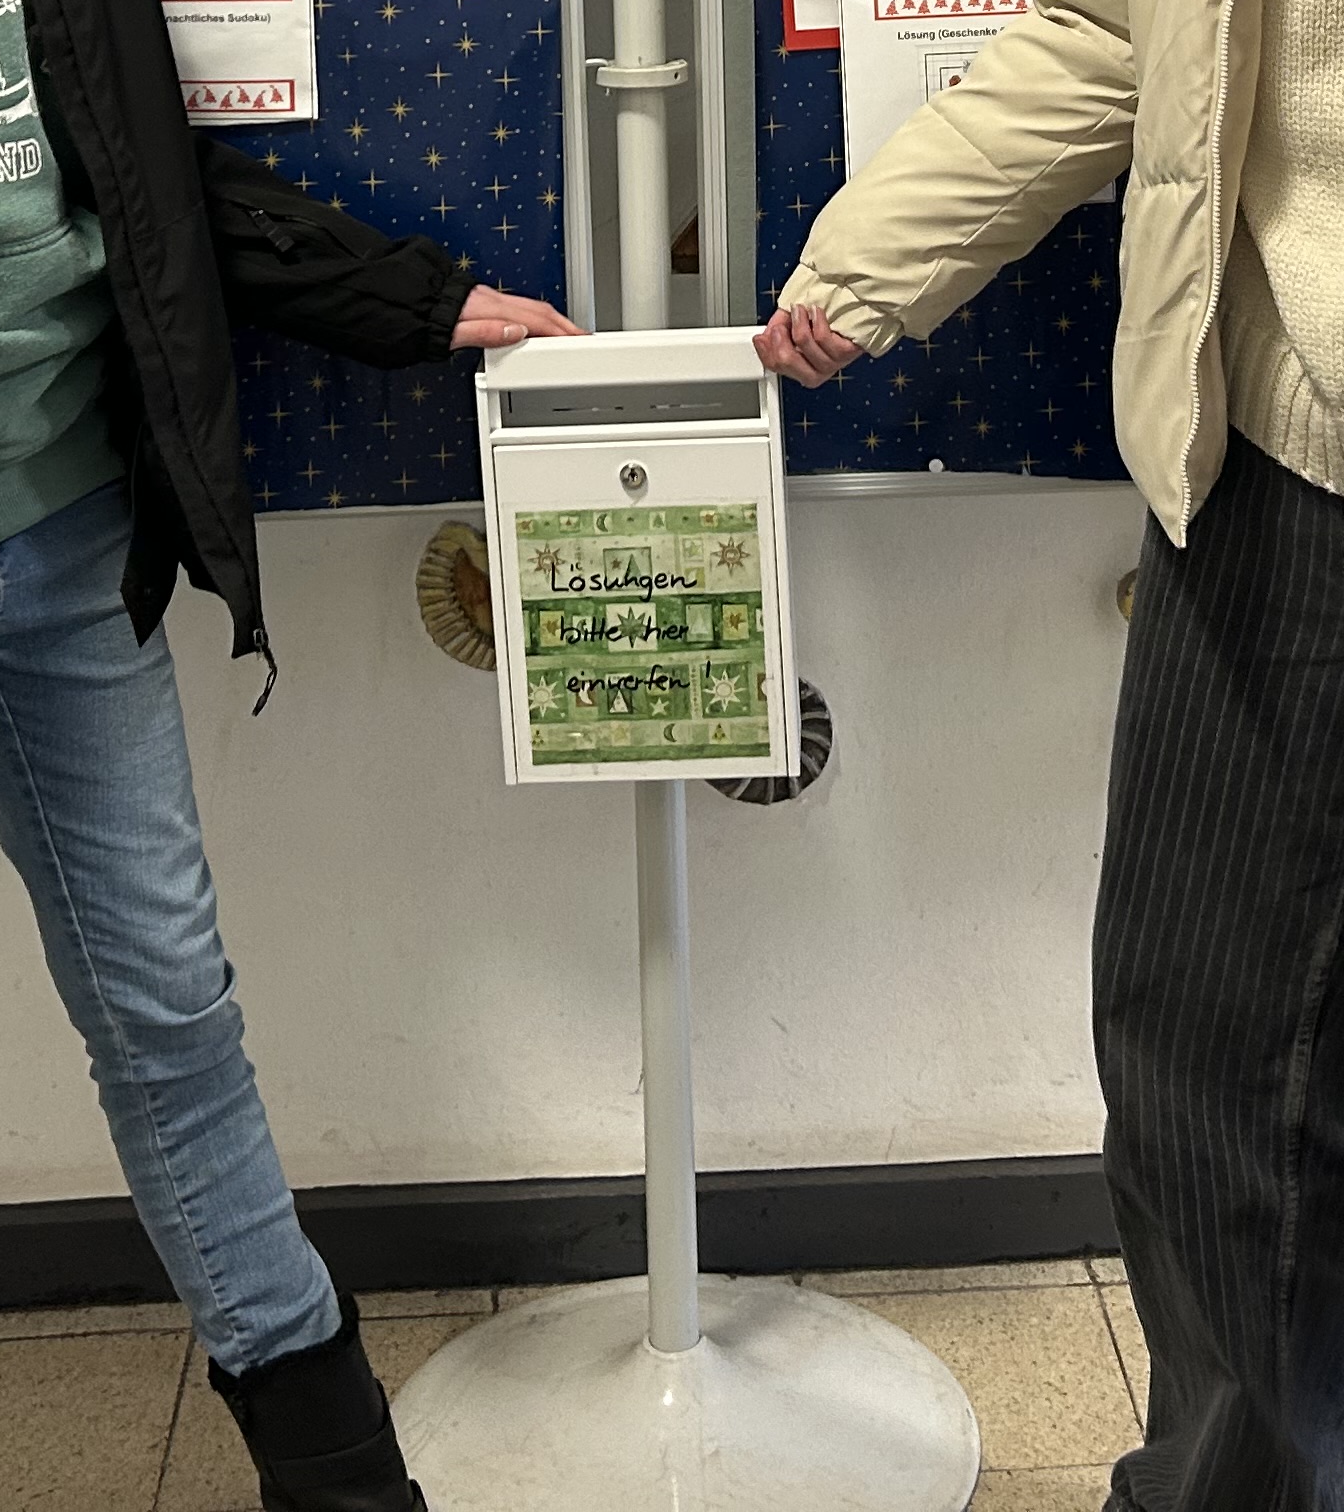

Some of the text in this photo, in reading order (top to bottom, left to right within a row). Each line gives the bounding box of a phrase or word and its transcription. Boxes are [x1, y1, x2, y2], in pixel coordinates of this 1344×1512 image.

[897, 28, 998, 41] Lösung (Geschenke
[551, 562, 697, 602] Lösungen
[560, 616, 689, 644] bitte hier
